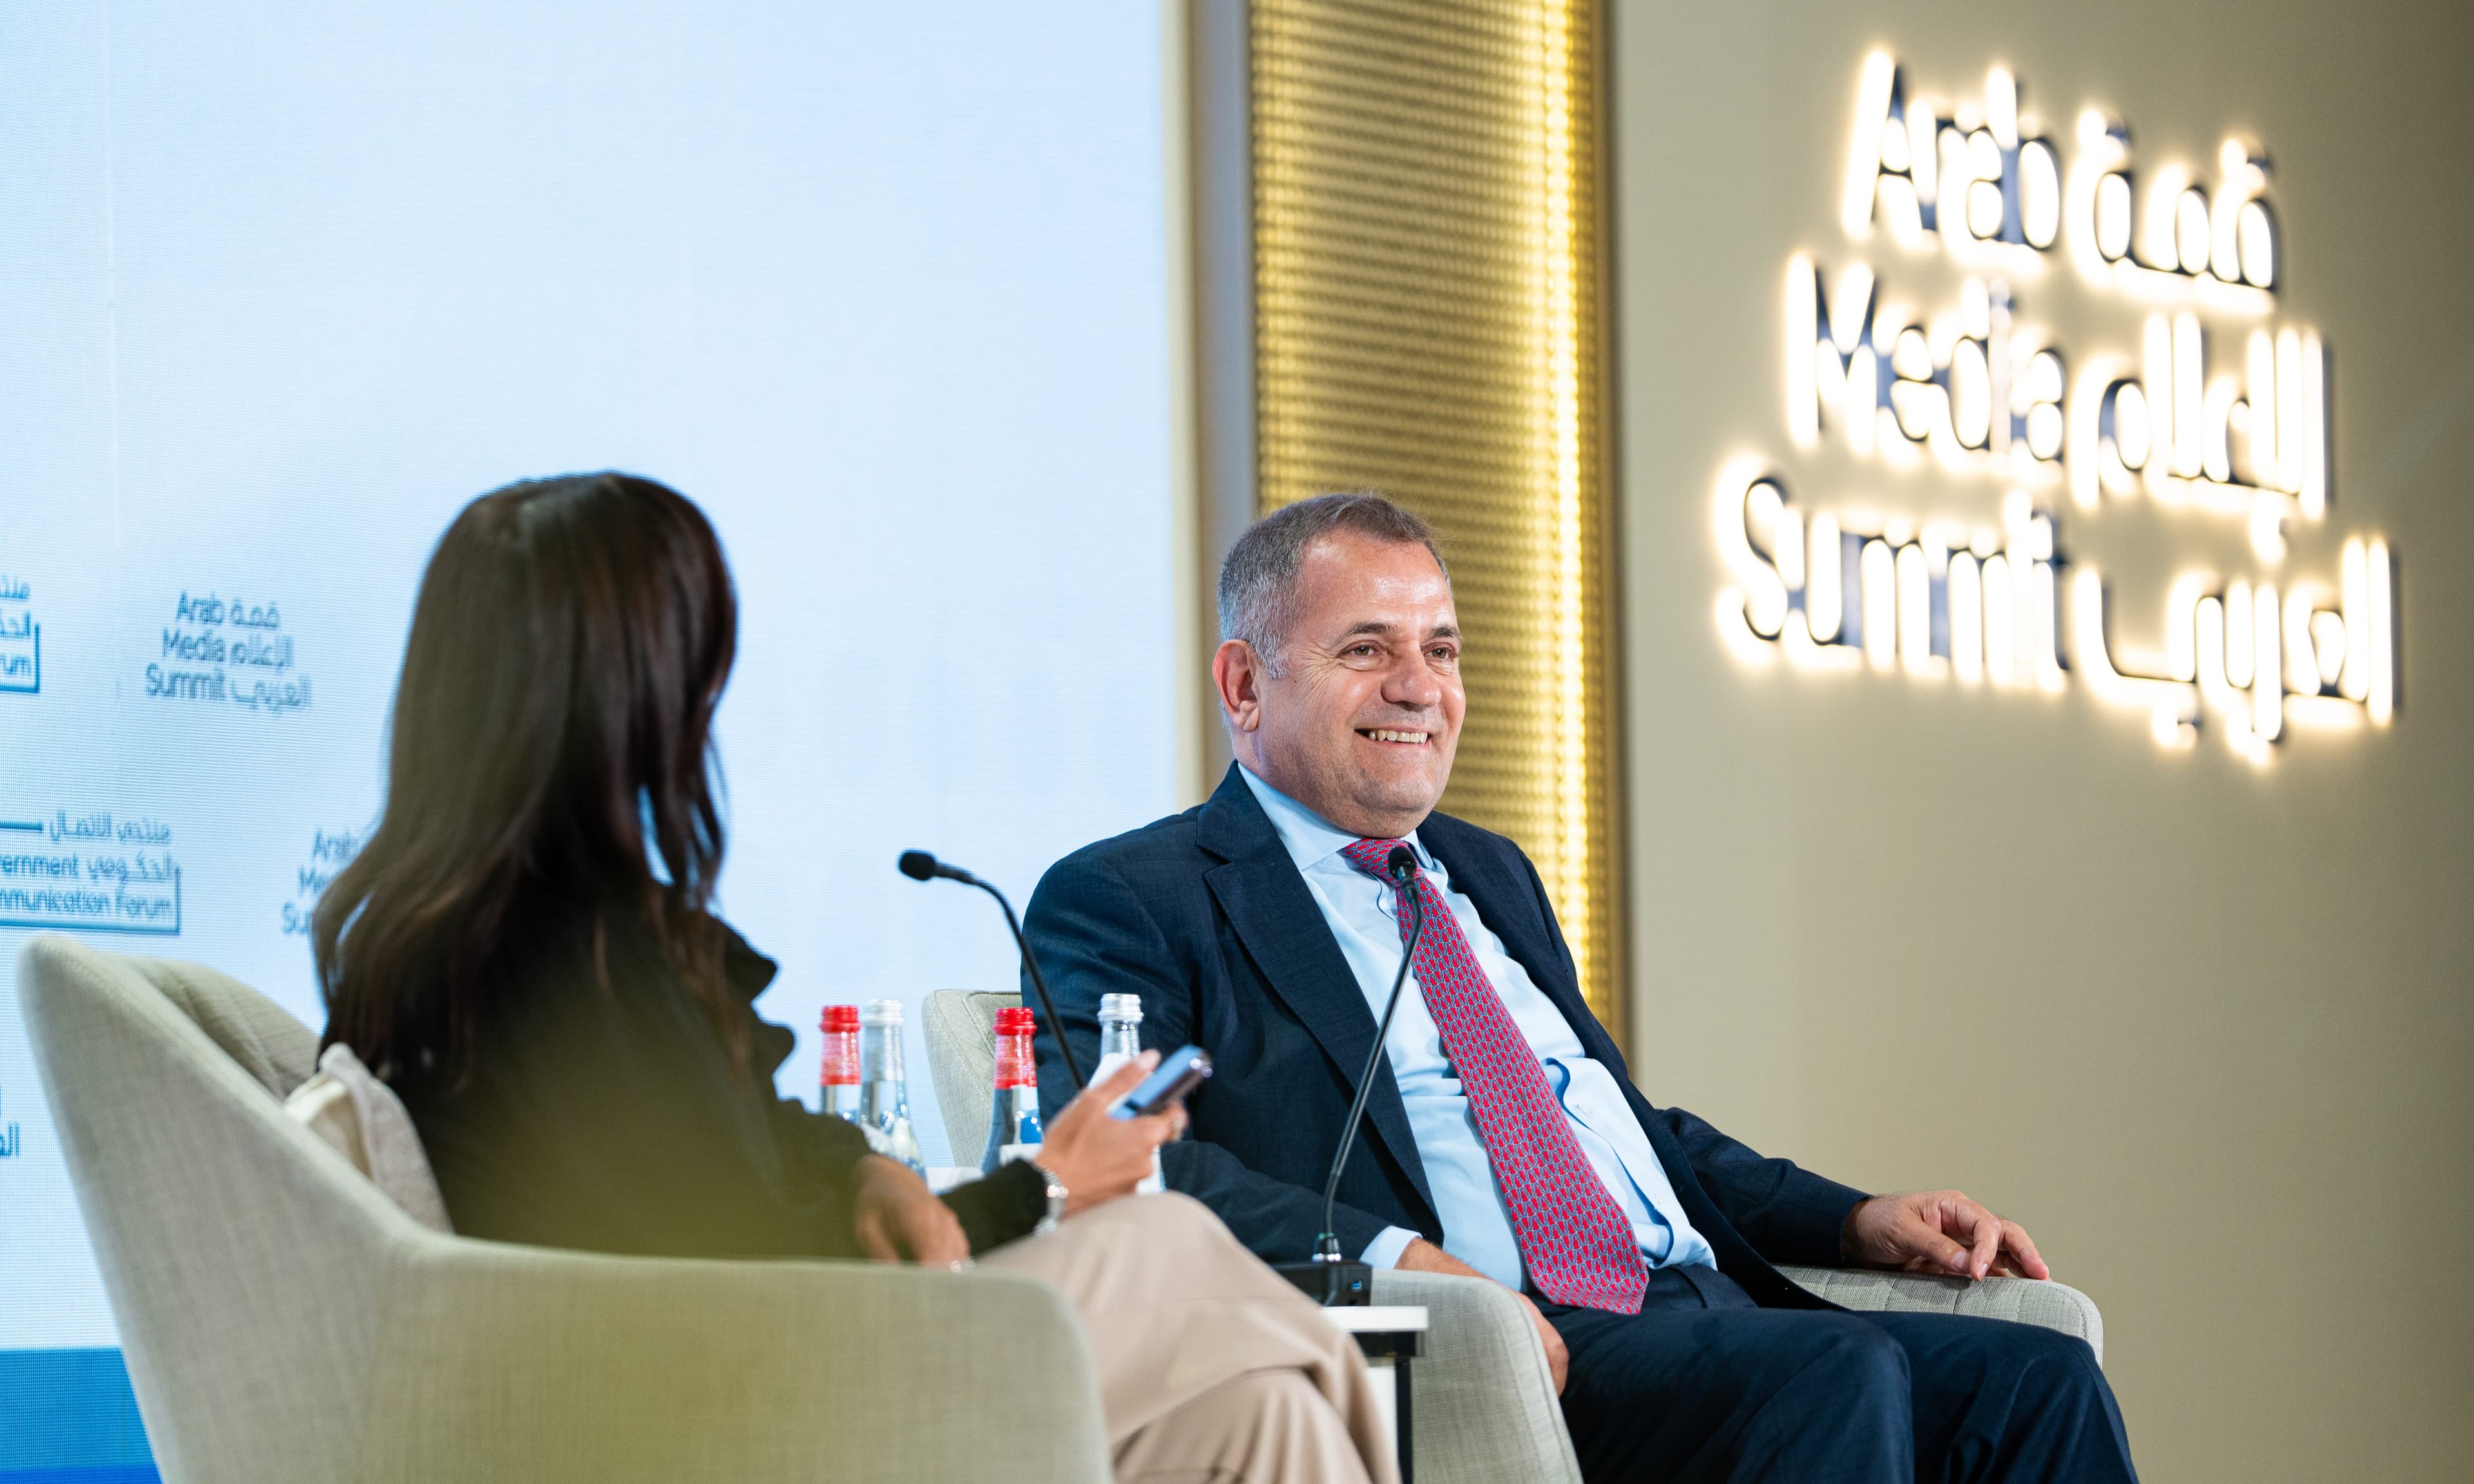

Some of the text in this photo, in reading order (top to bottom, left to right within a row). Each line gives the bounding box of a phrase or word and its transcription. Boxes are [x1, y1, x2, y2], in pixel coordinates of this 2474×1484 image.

[1841, 50, 2062, 276] Arab
[2064, 106, 2279, 314] قمة
[1785, 252, 2062, 482] Media
[1714, 461, 2069, 693] Summit
[177, 589, 225, 625] Arab
[229, 598, 280, 629] قمة
[162, 625, 225, 663] Media
[2073, 535, 2401, 765] العربي
[146, 661, 225, 701] Summit
[0, 851, 79, 877] ernment
[115, 886, 172, 919] Forum
